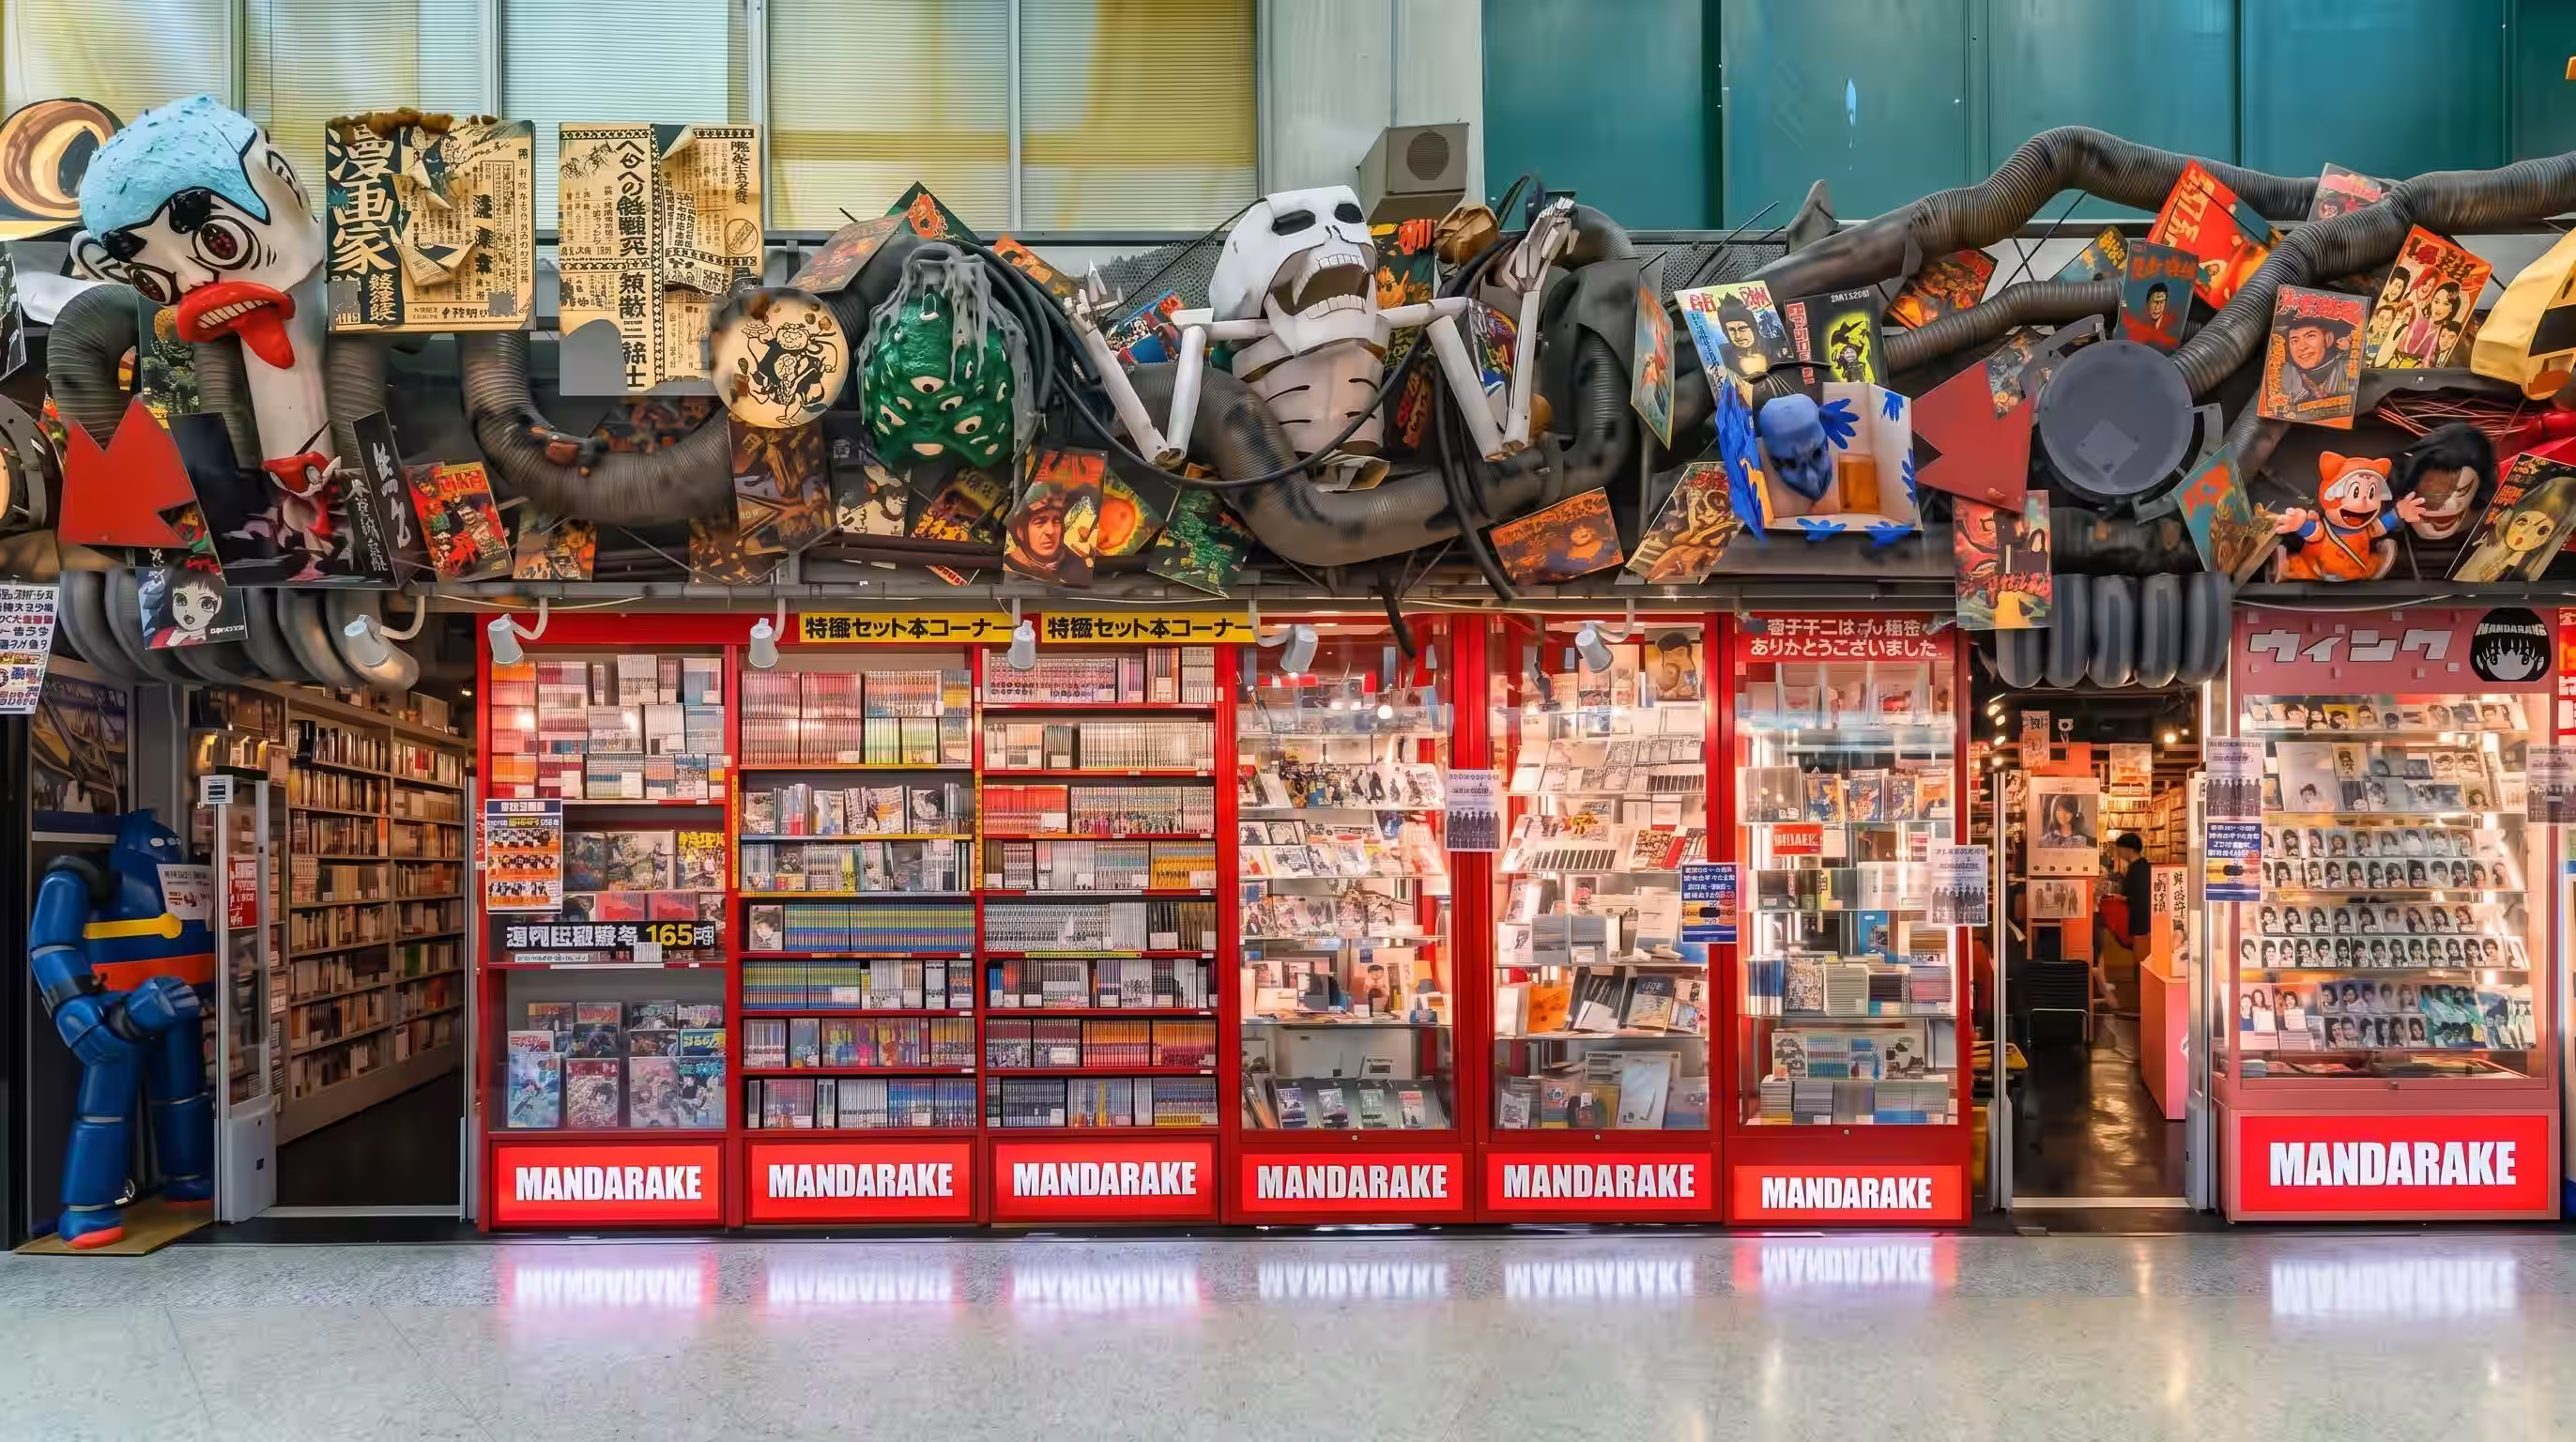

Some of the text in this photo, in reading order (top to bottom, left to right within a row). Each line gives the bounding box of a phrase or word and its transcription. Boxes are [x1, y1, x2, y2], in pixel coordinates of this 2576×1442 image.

[769, 1163, 953, 1198] MANDARAKE
[1013, 1161, 1197, 1196] MANDARAKE
[1504, 1164, 1694, 1198] MANDARAKE
[2271, 1141, 2516, 1186] MANDARAKE
[516, 1165, 702, 1201] MANDARAKE
[1258, 1165, 1448, 1199] MANDARAKE
[1762, 1176, 1932, 1209] MANDARAKE
